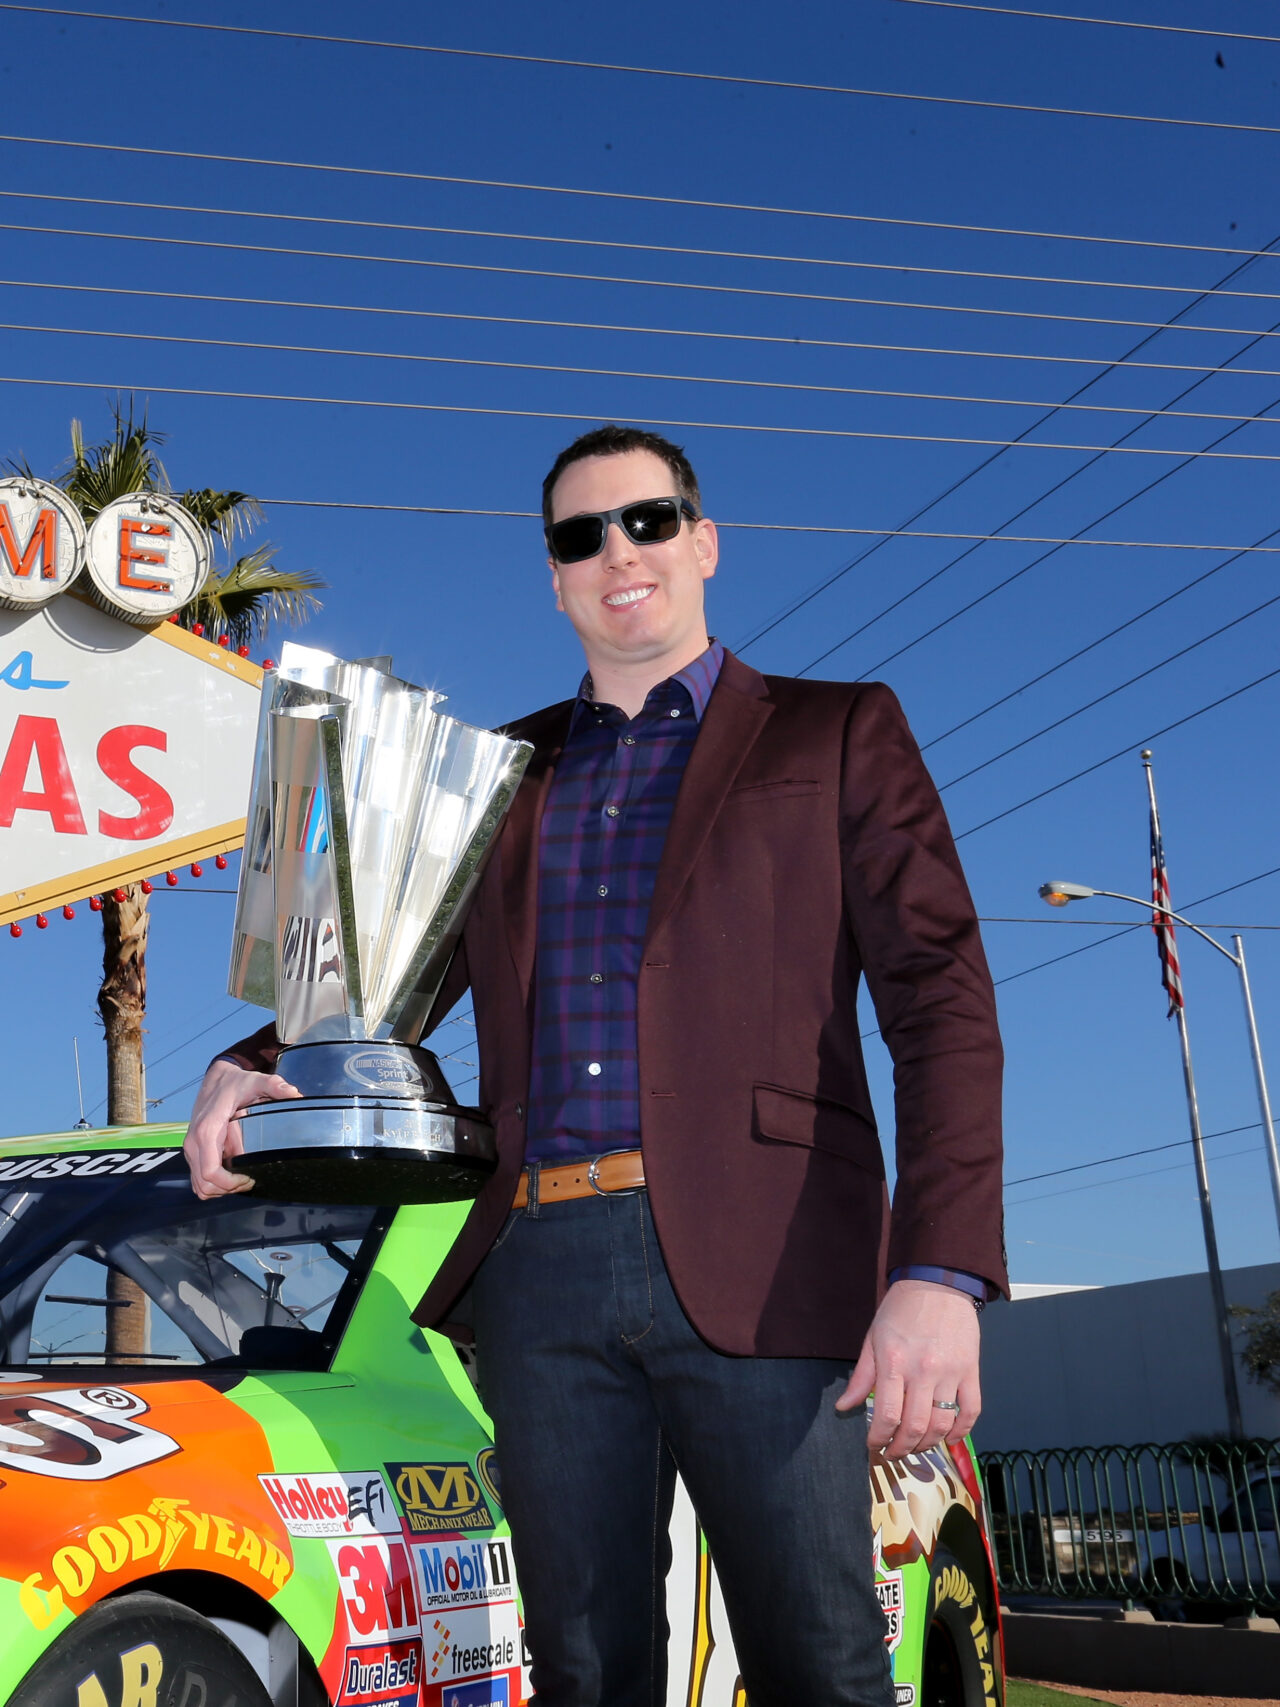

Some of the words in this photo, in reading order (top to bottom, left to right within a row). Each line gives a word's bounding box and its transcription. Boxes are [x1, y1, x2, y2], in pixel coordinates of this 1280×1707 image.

[377, 1068, 408, 1079] Sprint
[262, 1478, 353, 1532] Holley
[348, 1479, 385, 1527] EFI
[406, 1510, 462, 1531] MECHANIX
[462, 1507, 492, 1528] WEAR
[19, 1498, 291, 1631] GOODYEAR
[337, 1542, 418, 1635] 3M
[419, 1544, 487, 1594] Mobil
[490, 1543, 507, 1584] 1
[427, 1594, 450, 1606] OFFICIAL
[451, 1592, 469, 1603] MOTOR
[469, 1591, 478, 1600] OIL
[452, 1636, 513, 1674] freescale
[935, 1564, 996, 1707] GOODYEA
[347, 1649, 417, 1696] Duralast
